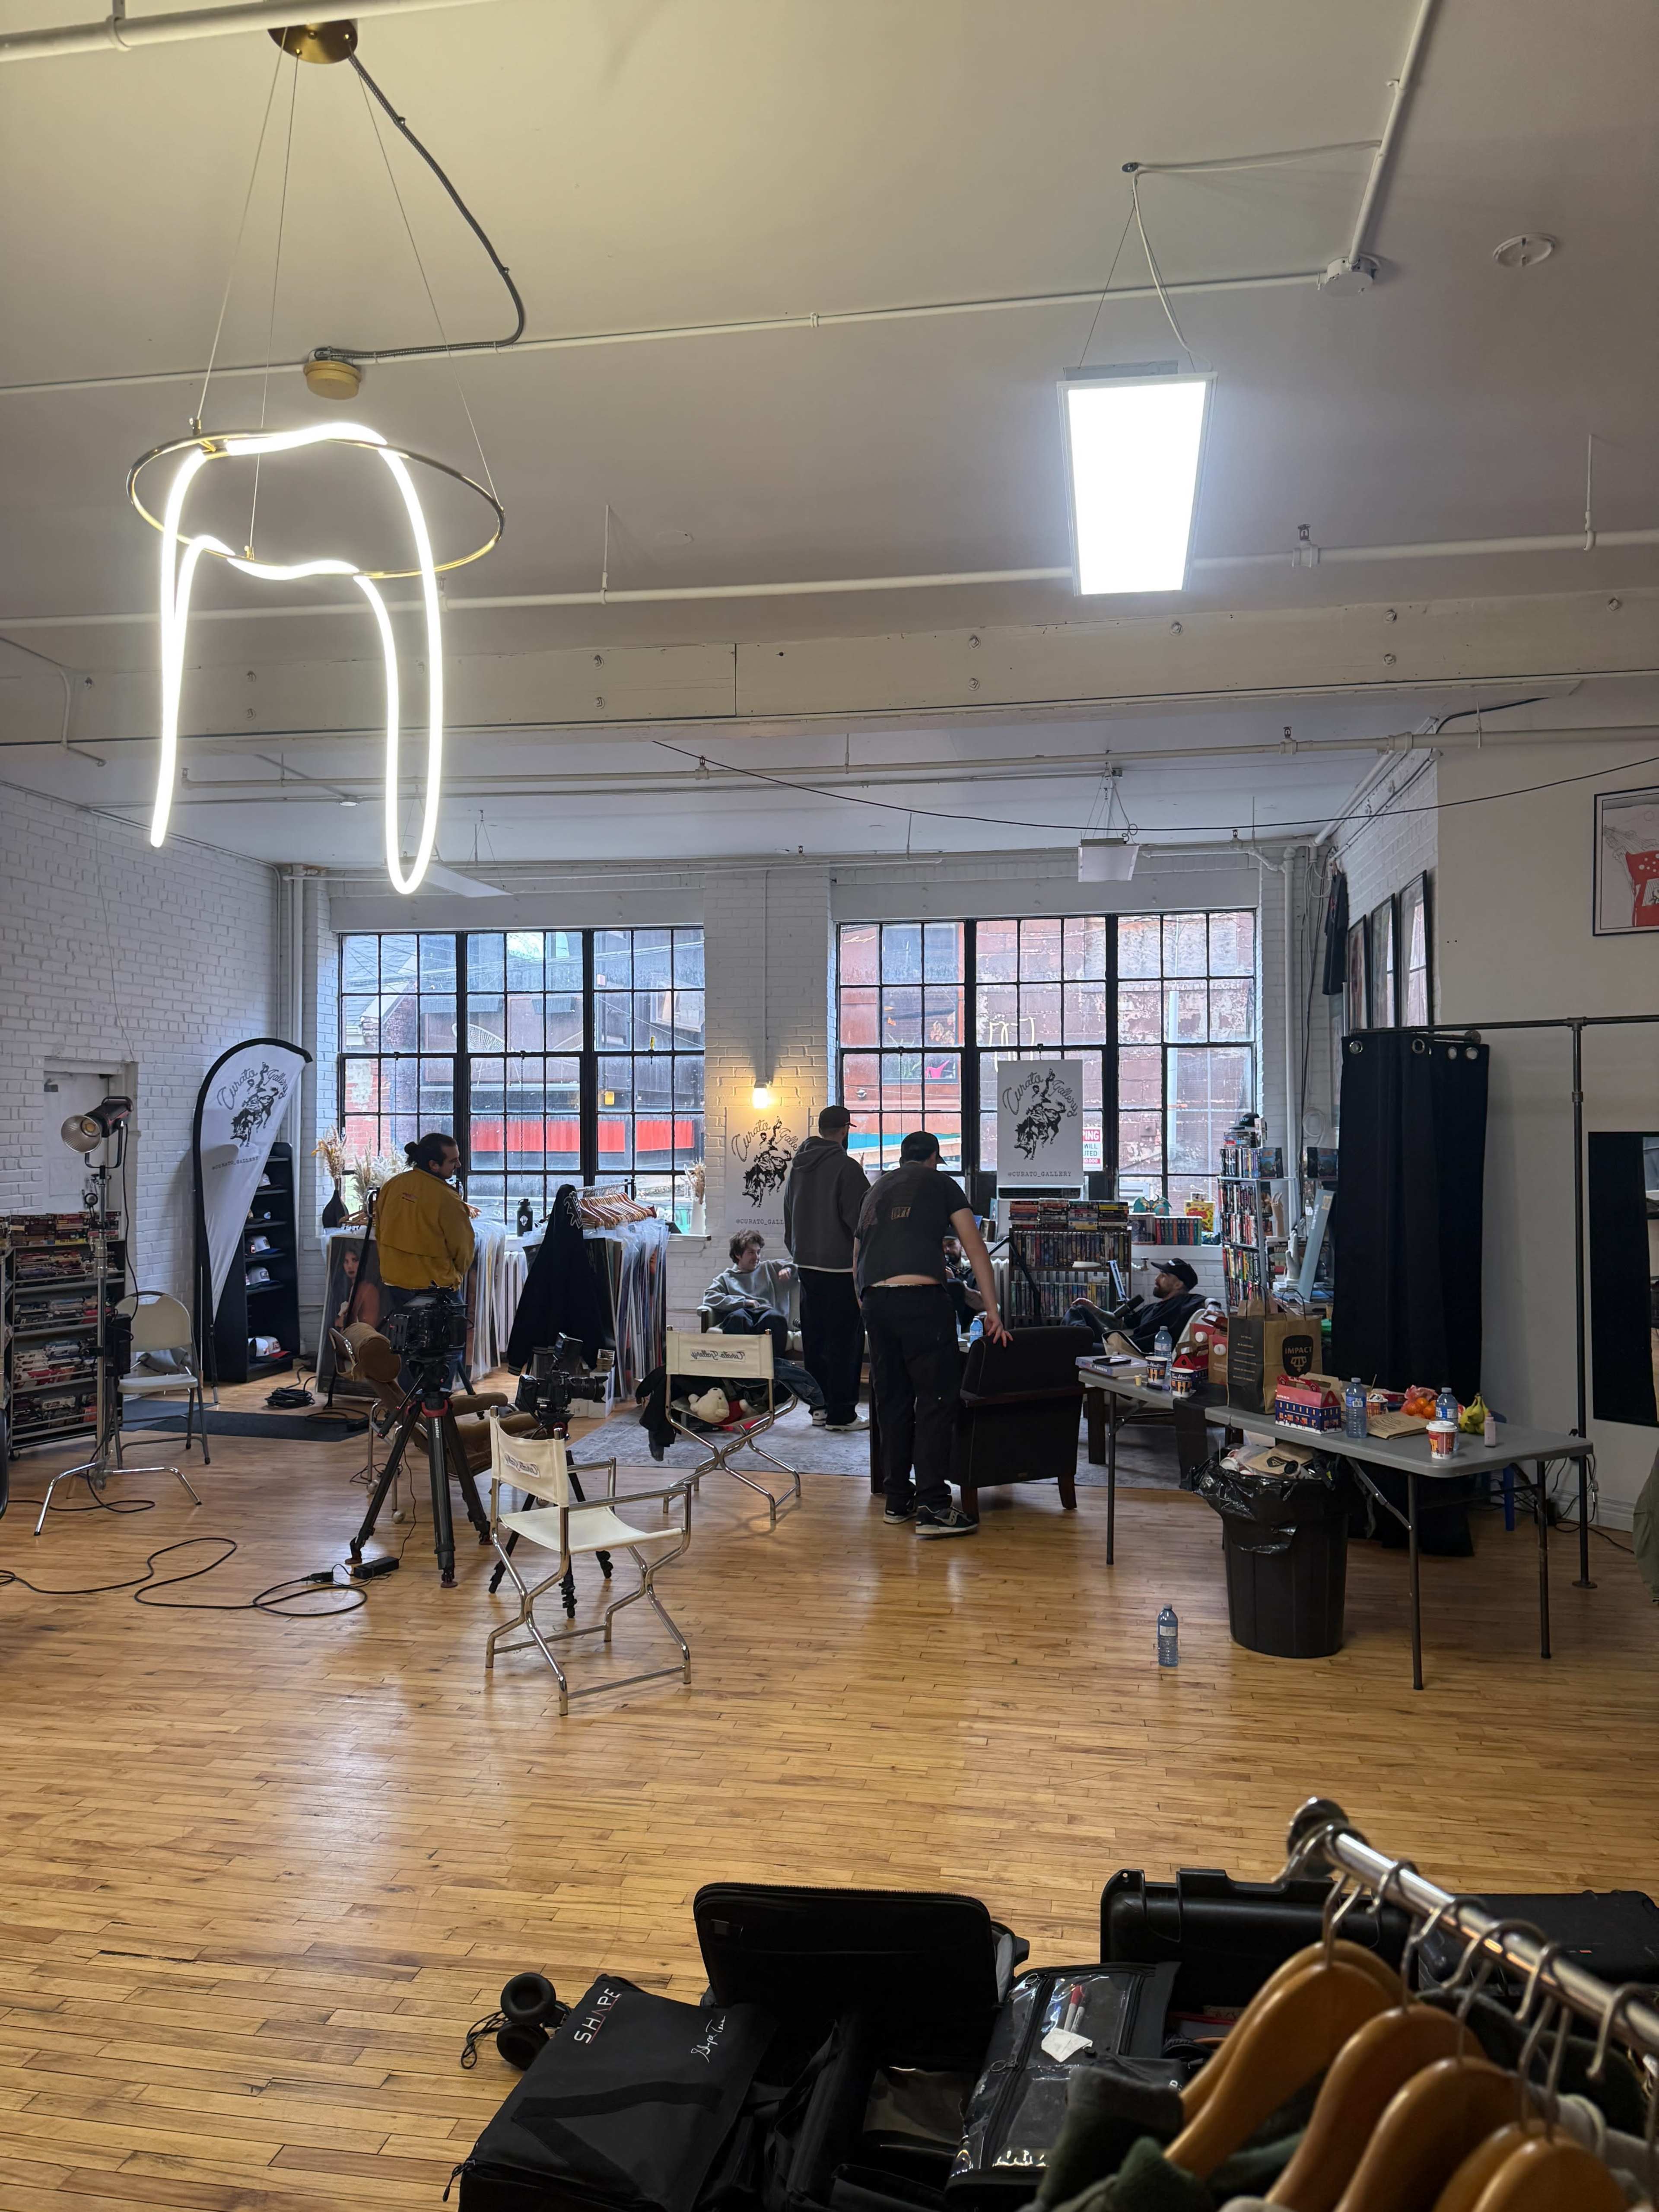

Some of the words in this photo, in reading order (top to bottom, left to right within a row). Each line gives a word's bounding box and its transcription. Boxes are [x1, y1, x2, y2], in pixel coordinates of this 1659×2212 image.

[217, 1068, 258, 1110] Curato
[263, 1069, 288, 1099] Gallery
[1002, 1072, 1043, 1115] Curato
[1048, 1080, 1078, 1117] Gallery
[731, 1120, 771, 1162] Curato
[775, 1128, 800, 1152] Galle
[1285, 1346, 1312, 1355] IMPACT
